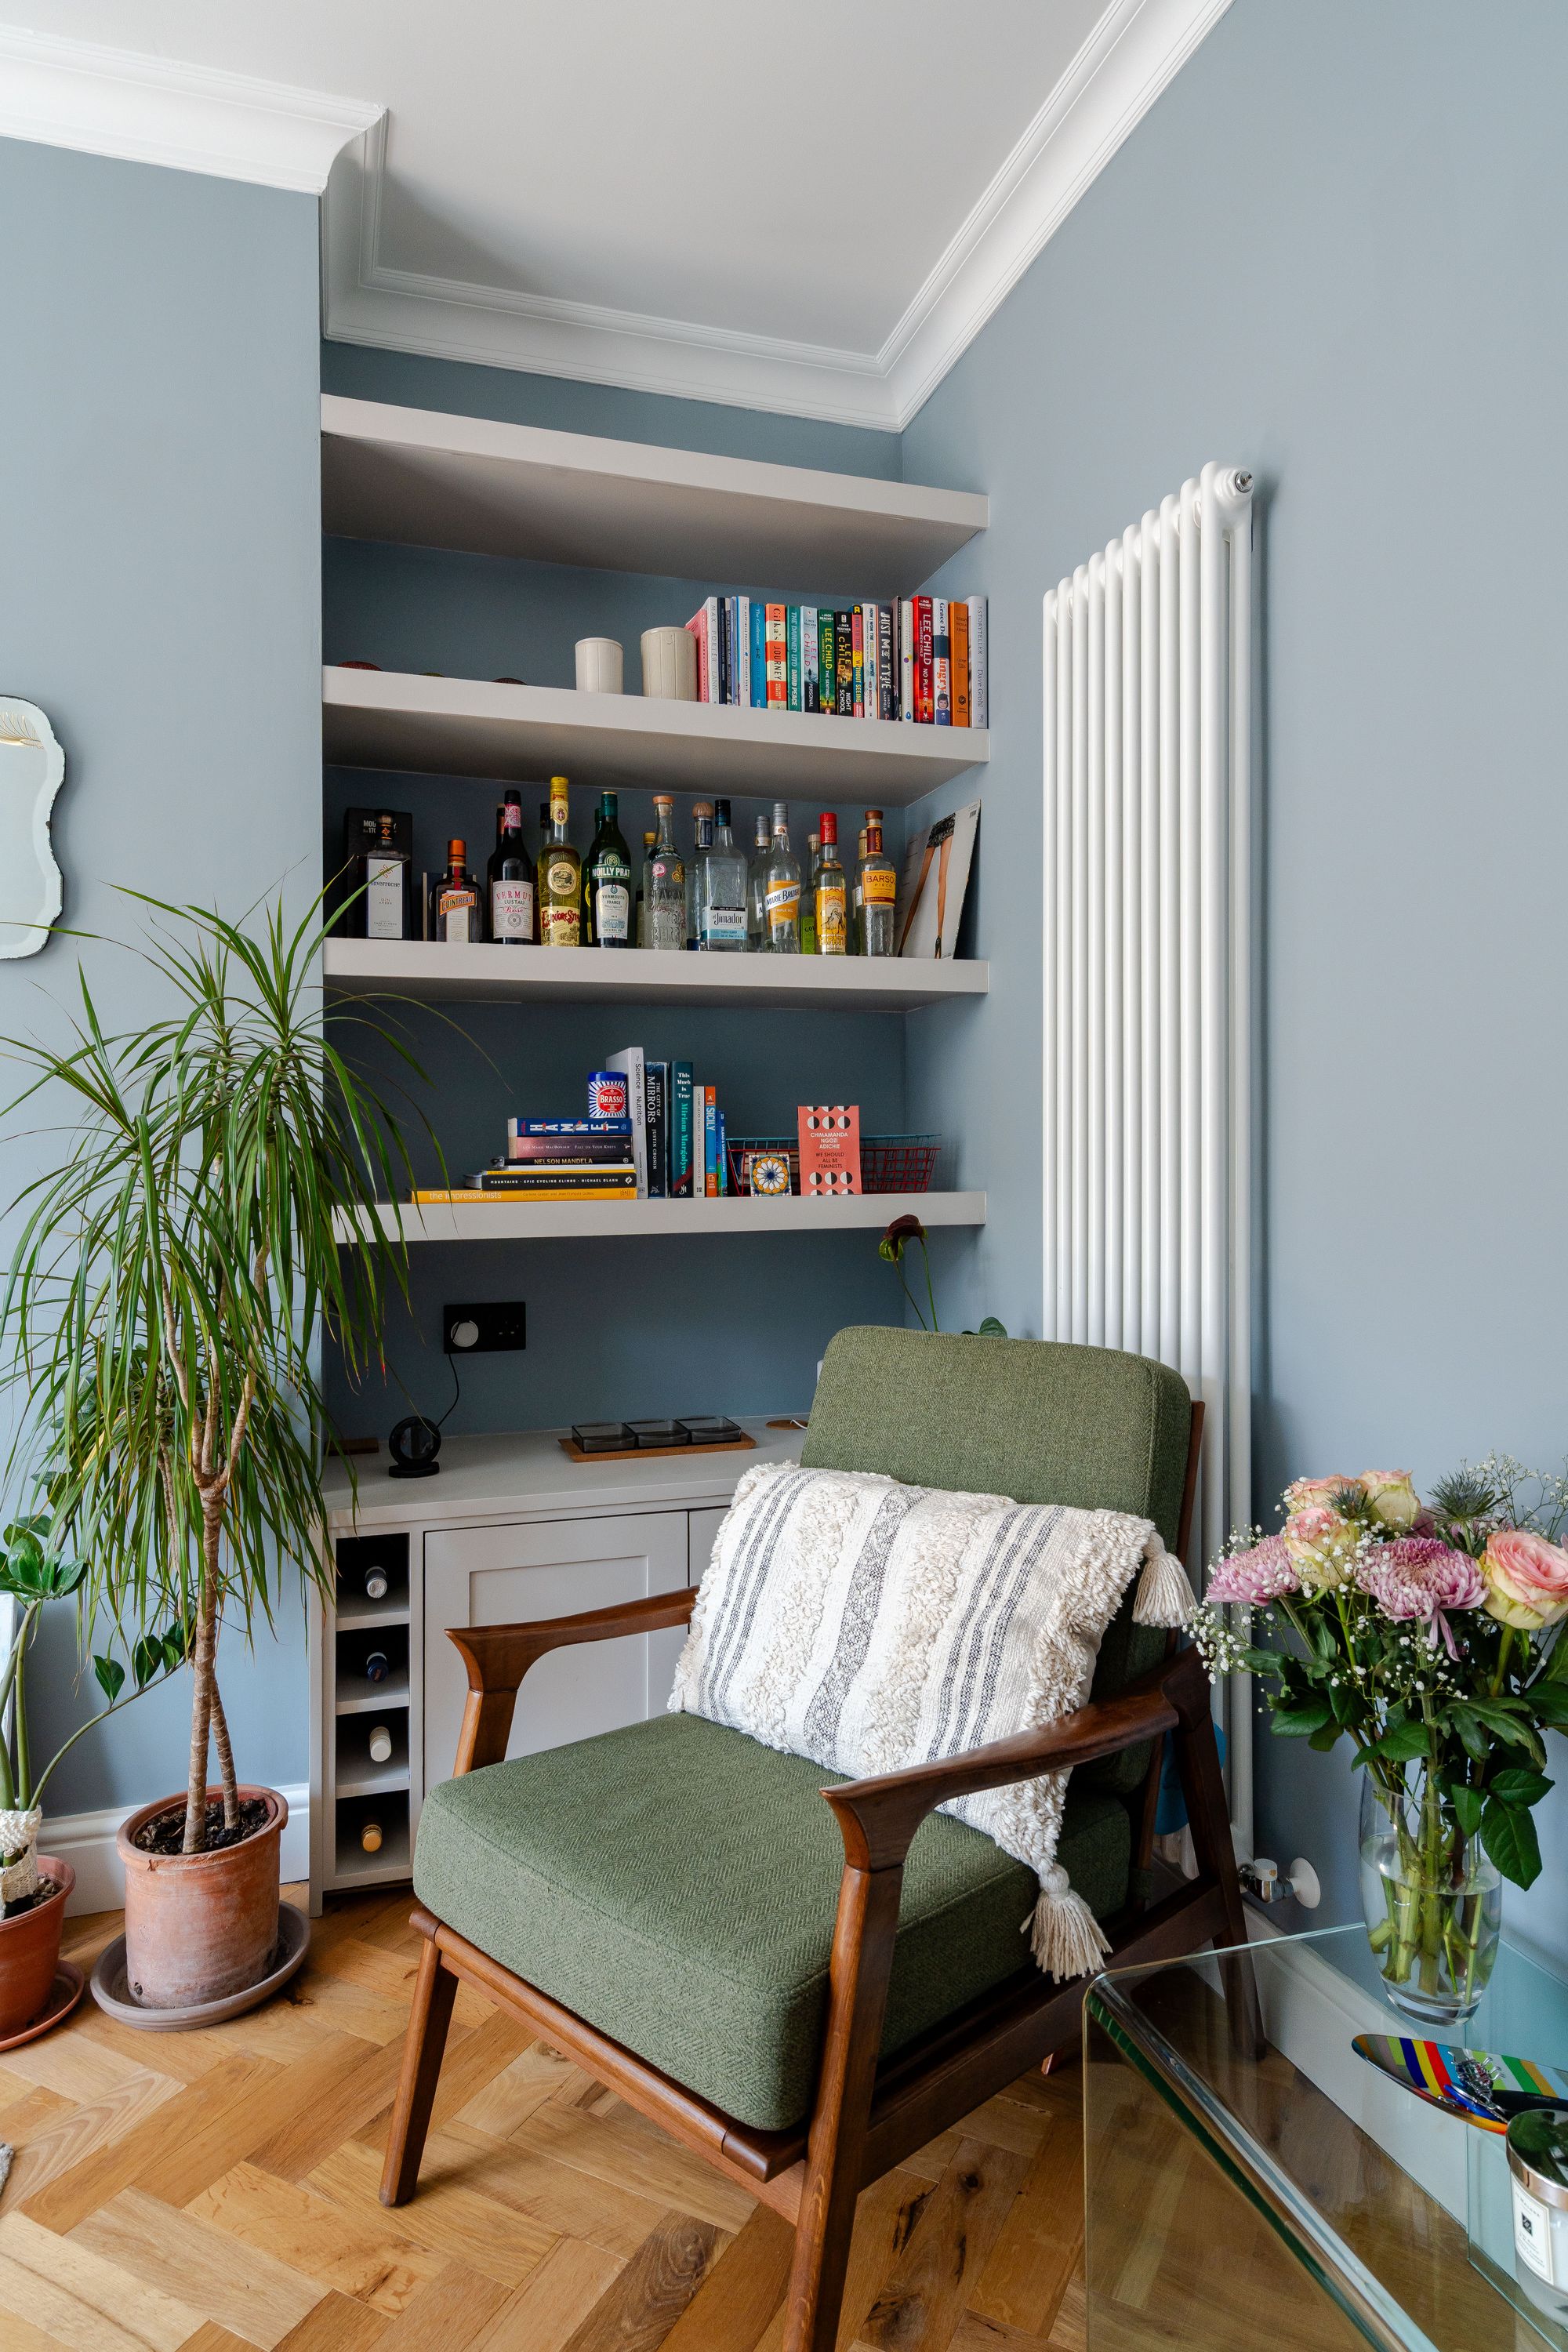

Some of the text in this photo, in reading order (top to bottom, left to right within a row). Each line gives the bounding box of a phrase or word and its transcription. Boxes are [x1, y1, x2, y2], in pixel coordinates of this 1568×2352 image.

[880, 612, 891, 635] JUST
[773, 646, 782, 680] JOURNEY
[880, 663, 891, 688] TYPE
[923, 668, 927, 677] NO
[937, 659, 947, 692] ungry
[592, 867, 630, 877] NOILLY PRAT
[441, 895, 473, 911] COINTREAU
[496, 891, 532, 901] VERMUT
[767, 895, 781, 906] MARIE
[714, 913, 743, 925] Jimador
[601, 1094, 622, 1103] BRASSO
[647, 1076, 655, 1123] MIRRORS
[706, 1107, 715, 1131] SICILY
[680, 1134, 688, 1175] Margolyes
[445, 1192, 502, 1200] impressionists
